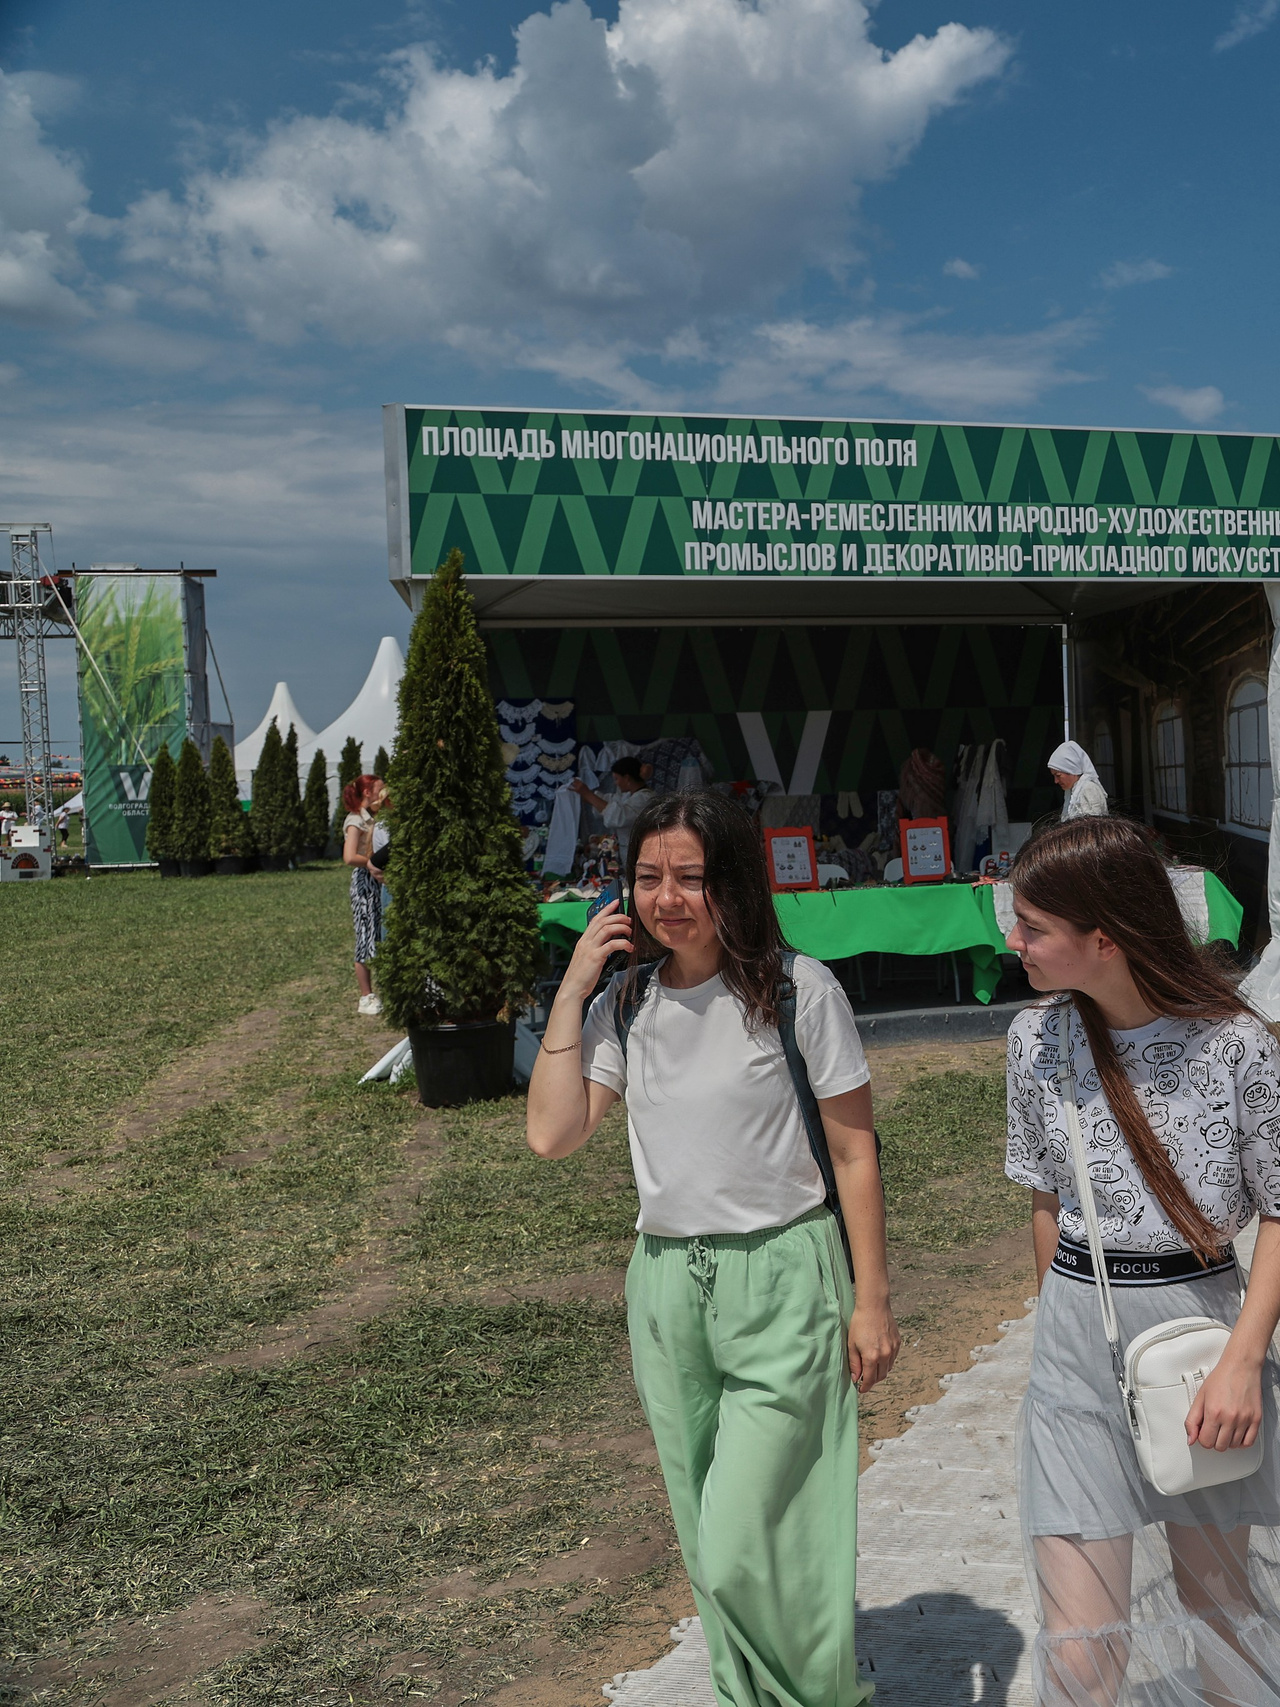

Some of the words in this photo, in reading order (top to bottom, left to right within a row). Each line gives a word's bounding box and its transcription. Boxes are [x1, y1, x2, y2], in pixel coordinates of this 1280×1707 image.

[422, 426, 555, 461] ПЛОЩАДЬ
[561, 430, 849, 466] МНОГОНАЦИОНАЛЬНОГО
[855, 438, 917, 466] ПОЛЯ
[692, 500, 992, 533] МАСТЕРА-РЕМЕСЛЕННИКИ
[684, 541, 836, 572] ПРОМЫСЛОВ
[842, 543, 858, 571] И
[863, 543, 1187, 574] ДЕКОРАТИВНО-ПРИКЛАДНОГО
[1190, 1065, 1206, 1076] OMG
[1113, 1262, 1161, 1274] FOCUS
